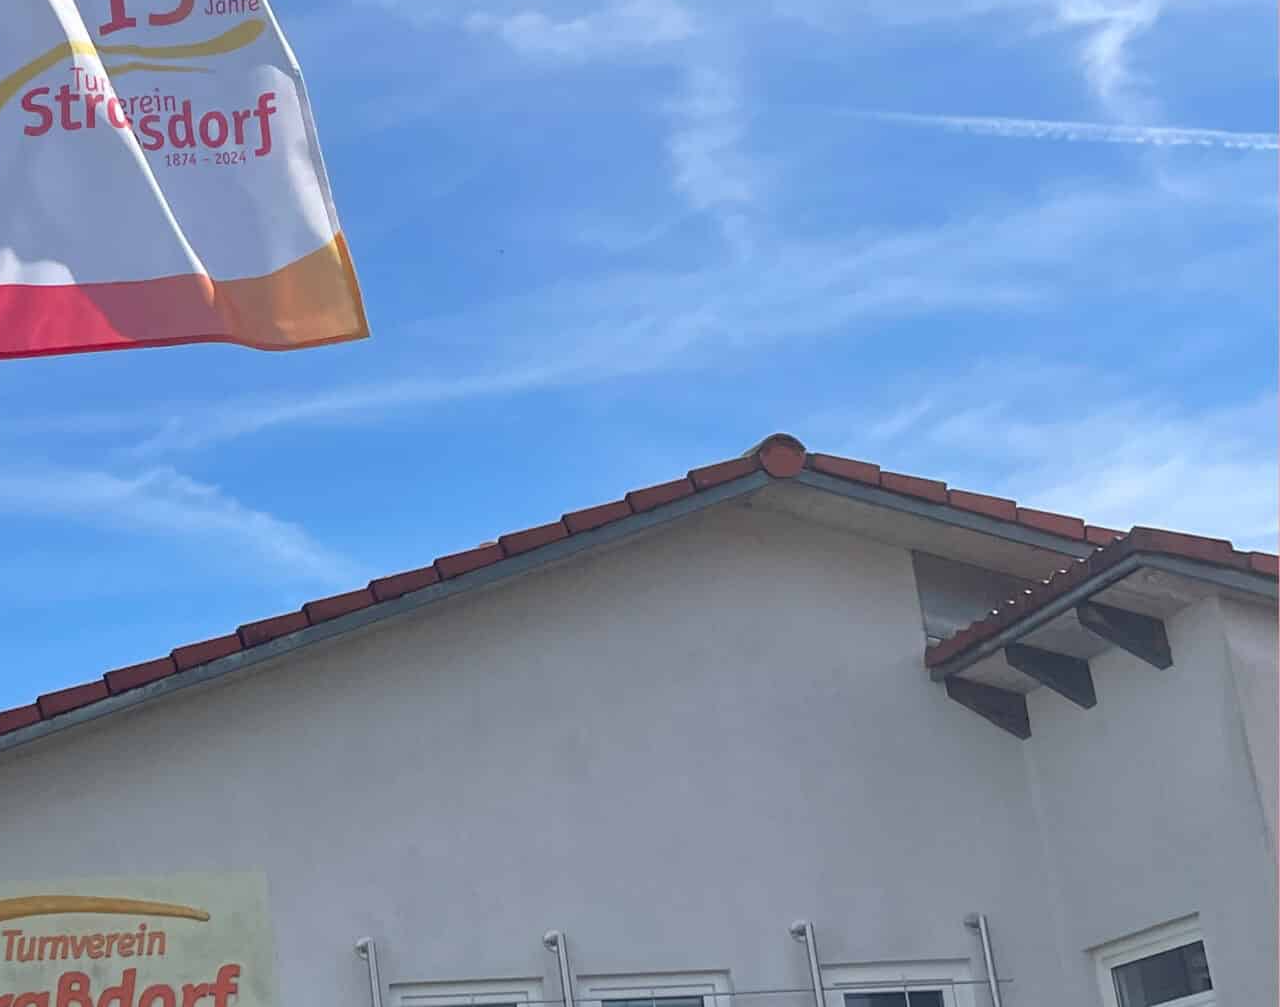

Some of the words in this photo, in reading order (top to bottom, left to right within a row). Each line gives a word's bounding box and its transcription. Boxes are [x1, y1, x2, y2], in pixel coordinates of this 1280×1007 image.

[21, 84, 277, 157] Strasdorf
[165, 153, 197, 167] 1874
[215, 152, 247, 165] 2024
[2, 923, 167, 963] Turnverein
